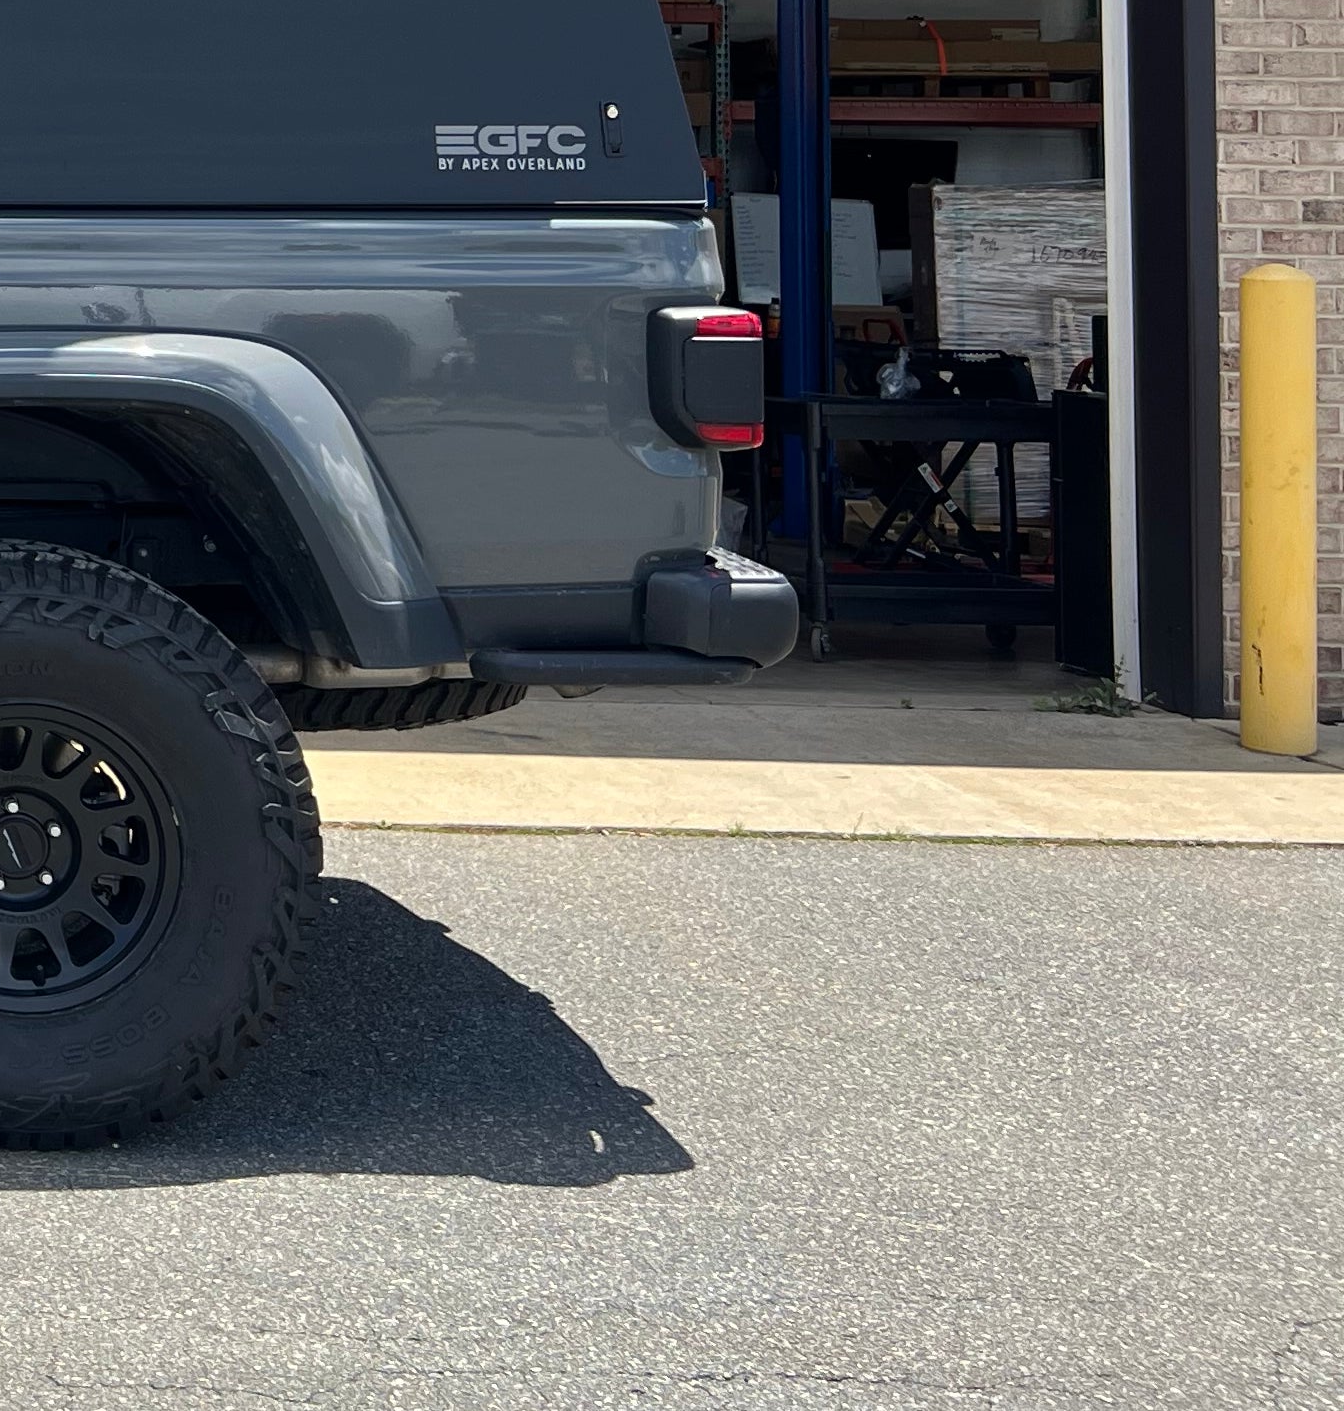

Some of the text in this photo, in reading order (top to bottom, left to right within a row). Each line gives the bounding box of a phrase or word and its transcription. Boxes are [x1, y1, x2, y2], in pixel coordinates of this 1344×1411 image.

[438, 157, 586, 171] BY APEX OVERLAND
